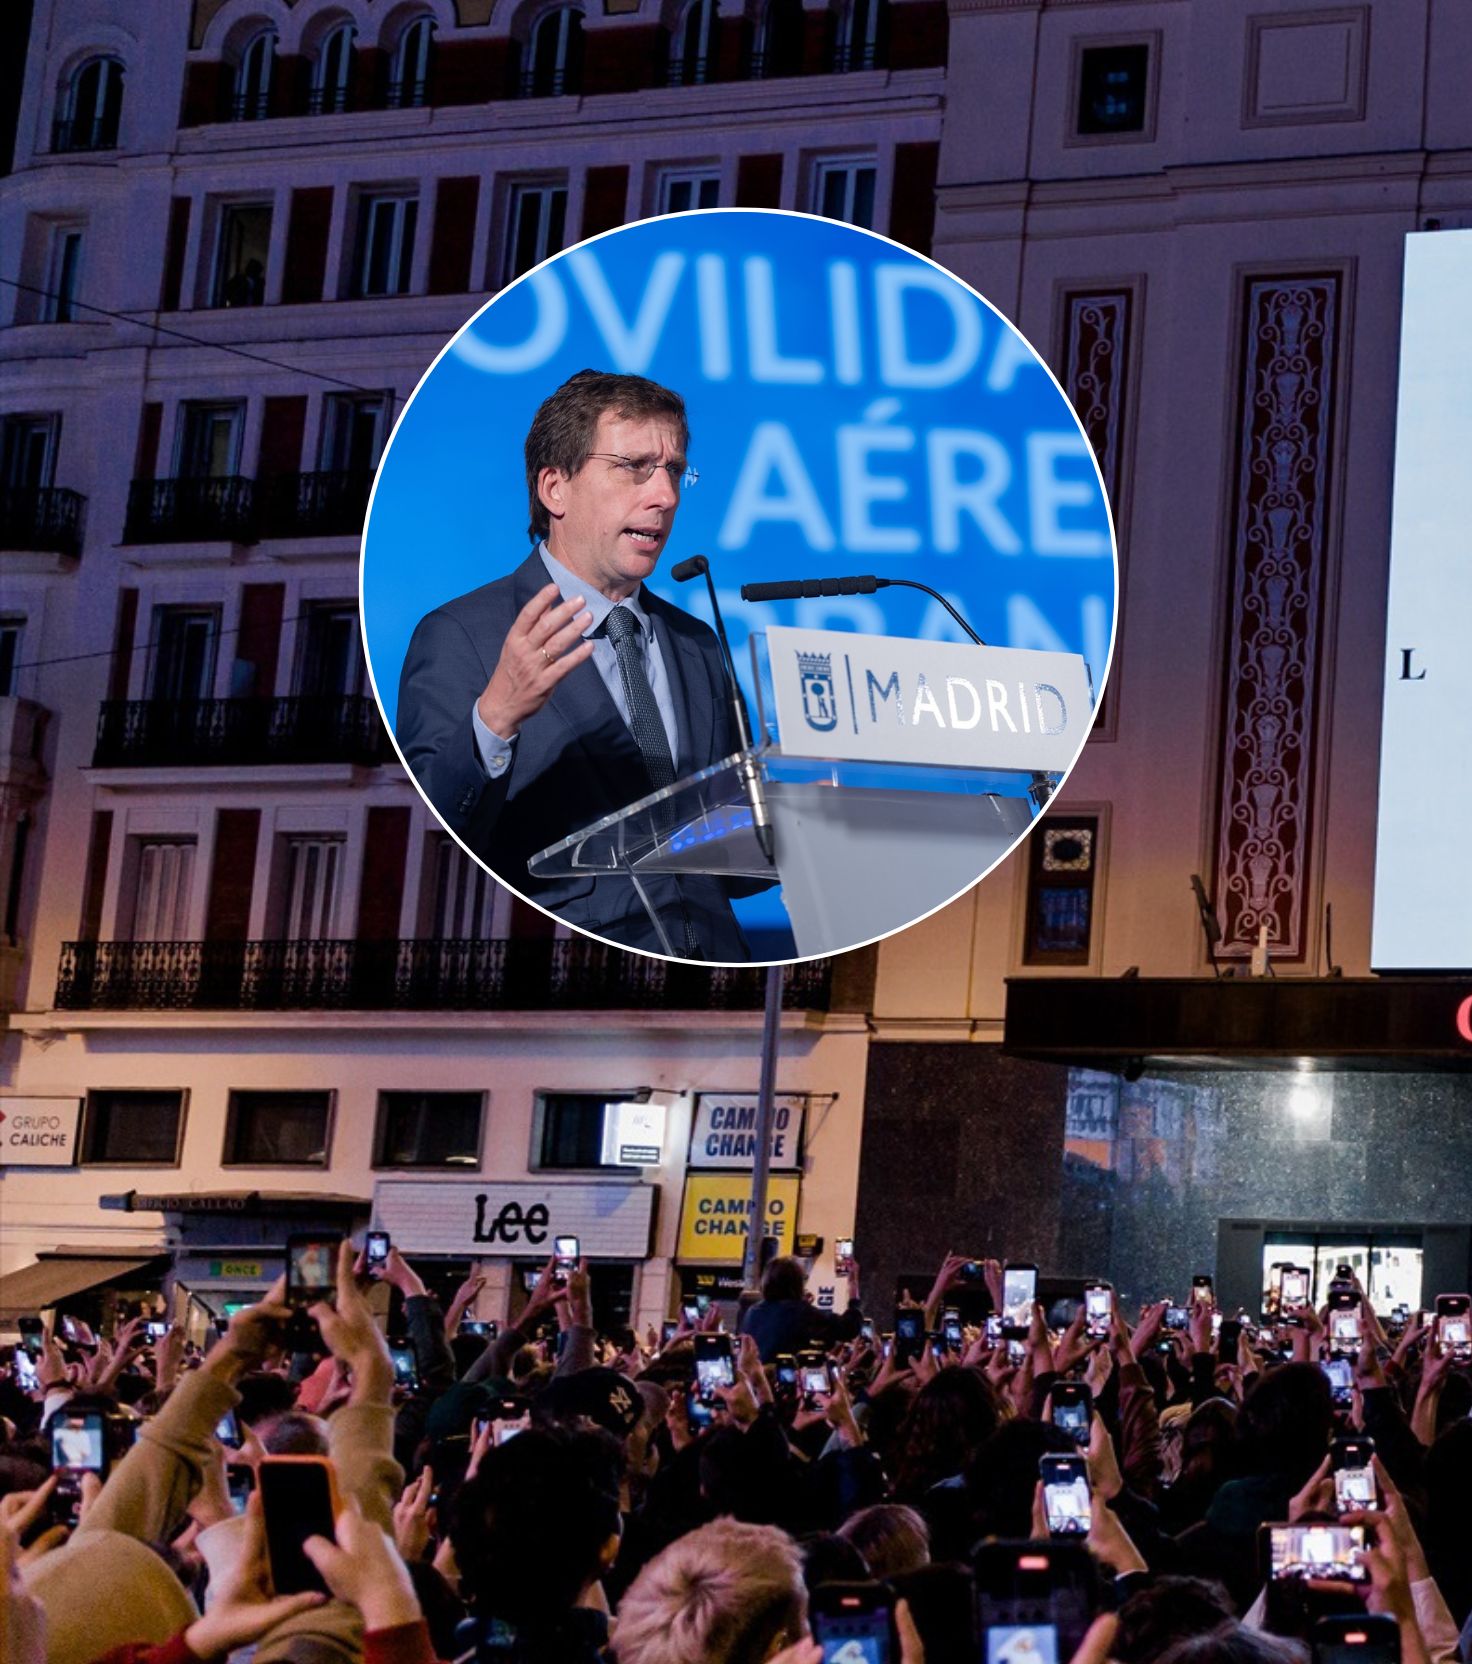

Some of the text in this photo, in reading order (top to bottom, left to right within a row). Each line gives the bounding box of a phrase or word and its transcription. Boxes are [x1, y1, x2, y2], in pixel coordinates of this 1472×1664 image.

[1399, 647, 1427, 681] L
[865, 668, 1068, 736] MADRID
[12, 1116, 60, 1130] GRUPO
[710, 1106, 790, 1131] CAMO
[9, 1133, 67, 1147] CALICHE
[705, 1133, 785, 1157] CHANE
[473, 1194, 549, 1245] Lee
[698, 1199, 785, 1216] CAMO
